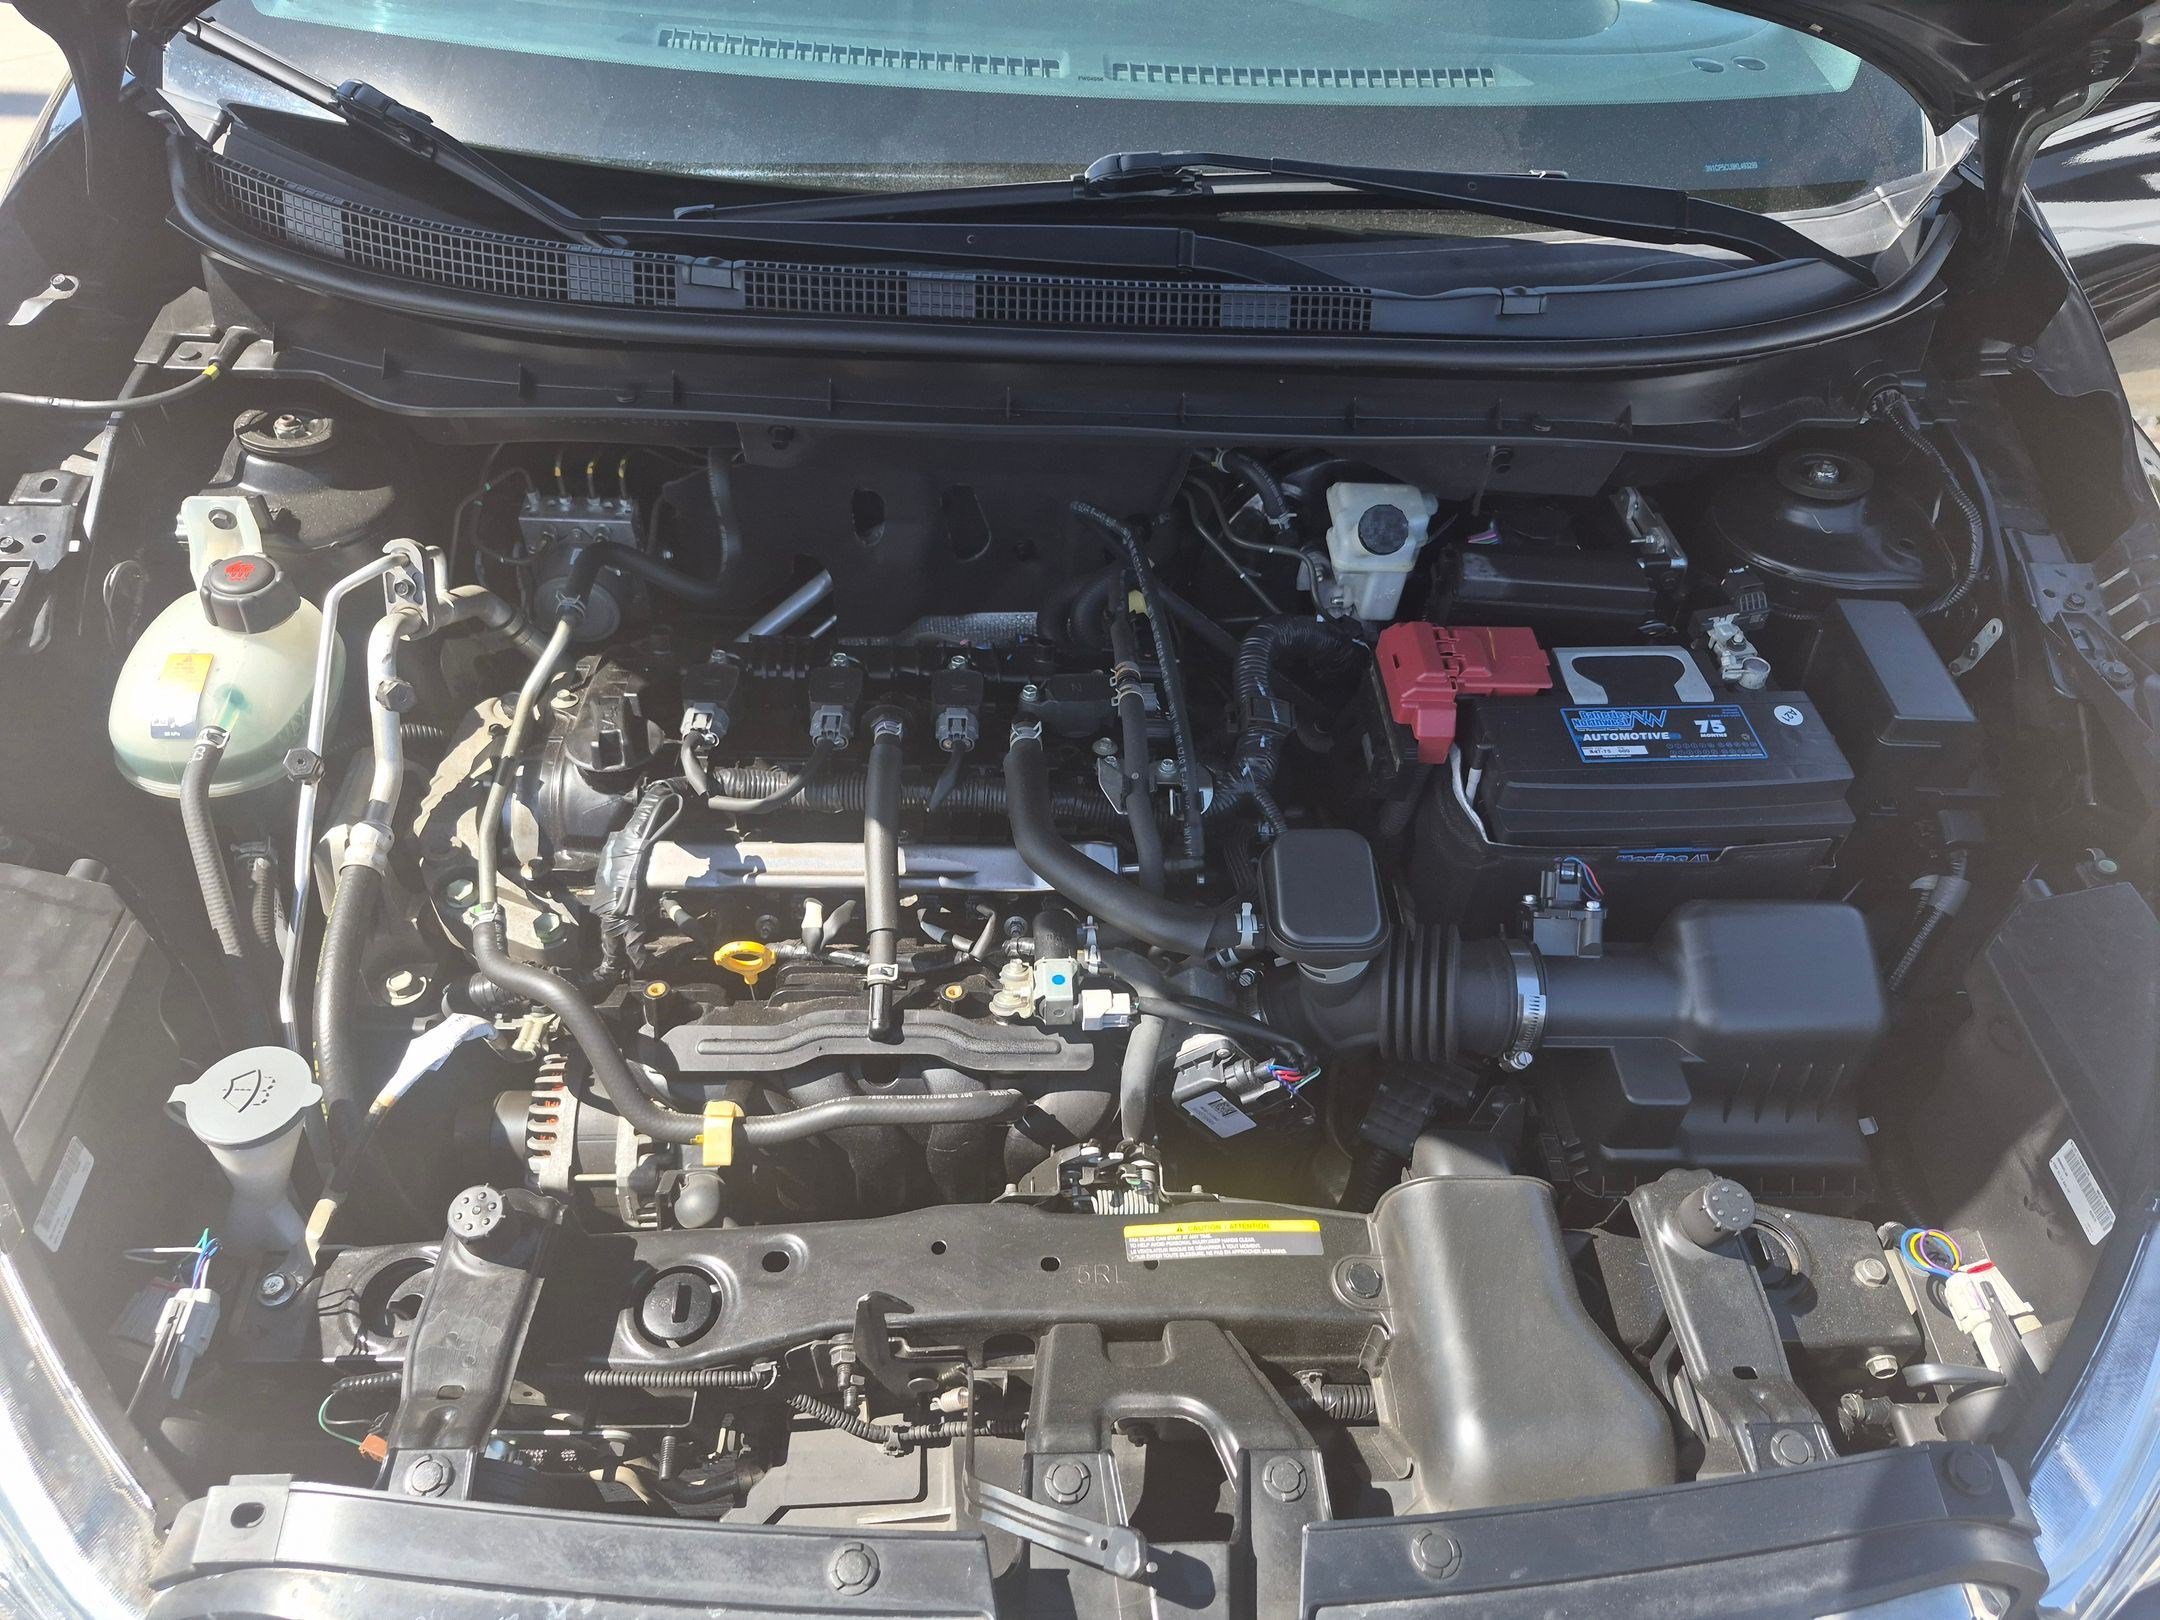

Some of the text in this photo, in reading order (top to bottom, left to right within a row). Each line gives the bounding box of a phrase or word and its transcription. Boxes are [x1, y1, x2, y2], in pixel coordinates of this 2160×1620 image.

[1782, 708, 1798, 722] A21
[1694, 719, 1726, 733] 75
[1583, 731, 1670, 742] AUTOMOTIVE
[1078, 1263, 1129, 1284] 5RL
